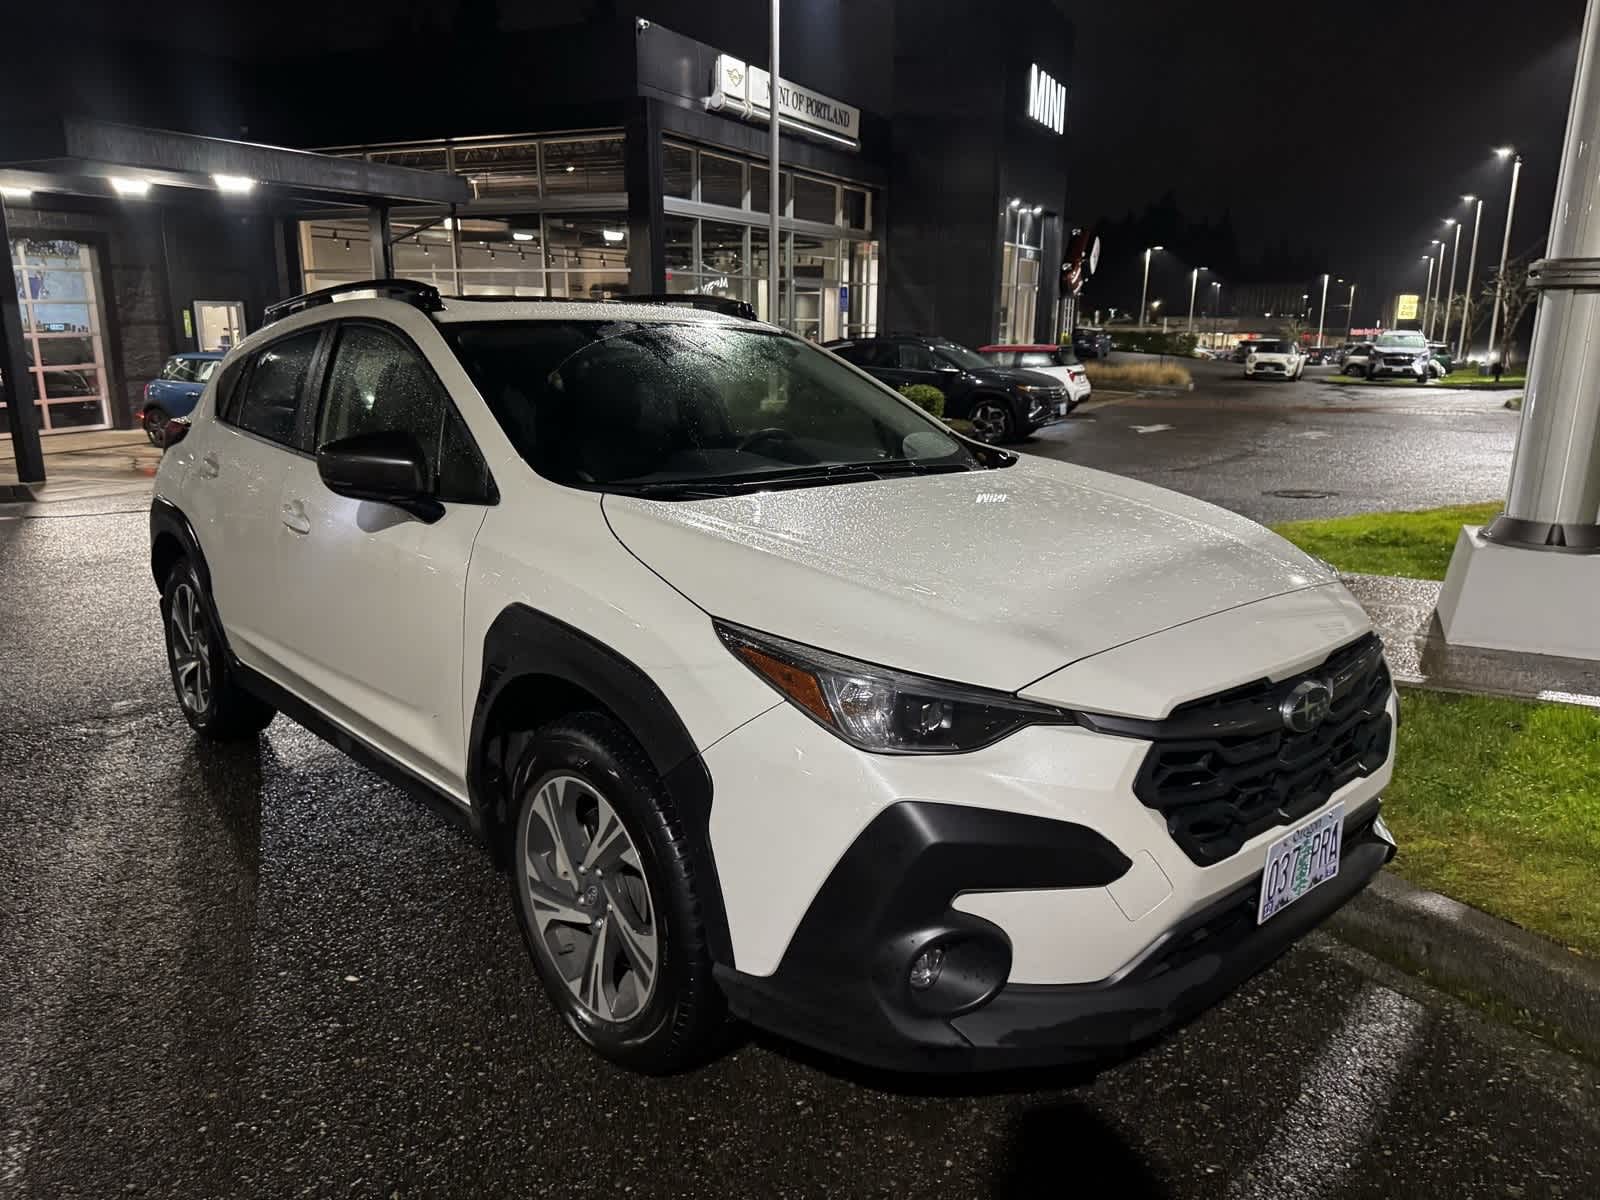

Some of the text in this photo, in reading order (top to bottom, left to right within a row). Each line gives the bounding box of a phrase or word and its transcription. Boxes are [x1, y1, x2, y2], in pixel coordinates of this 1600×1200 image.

[766, 81, 850, 128] NI OF PORTLAND
[1029, 63, 1066, 135] MINI
